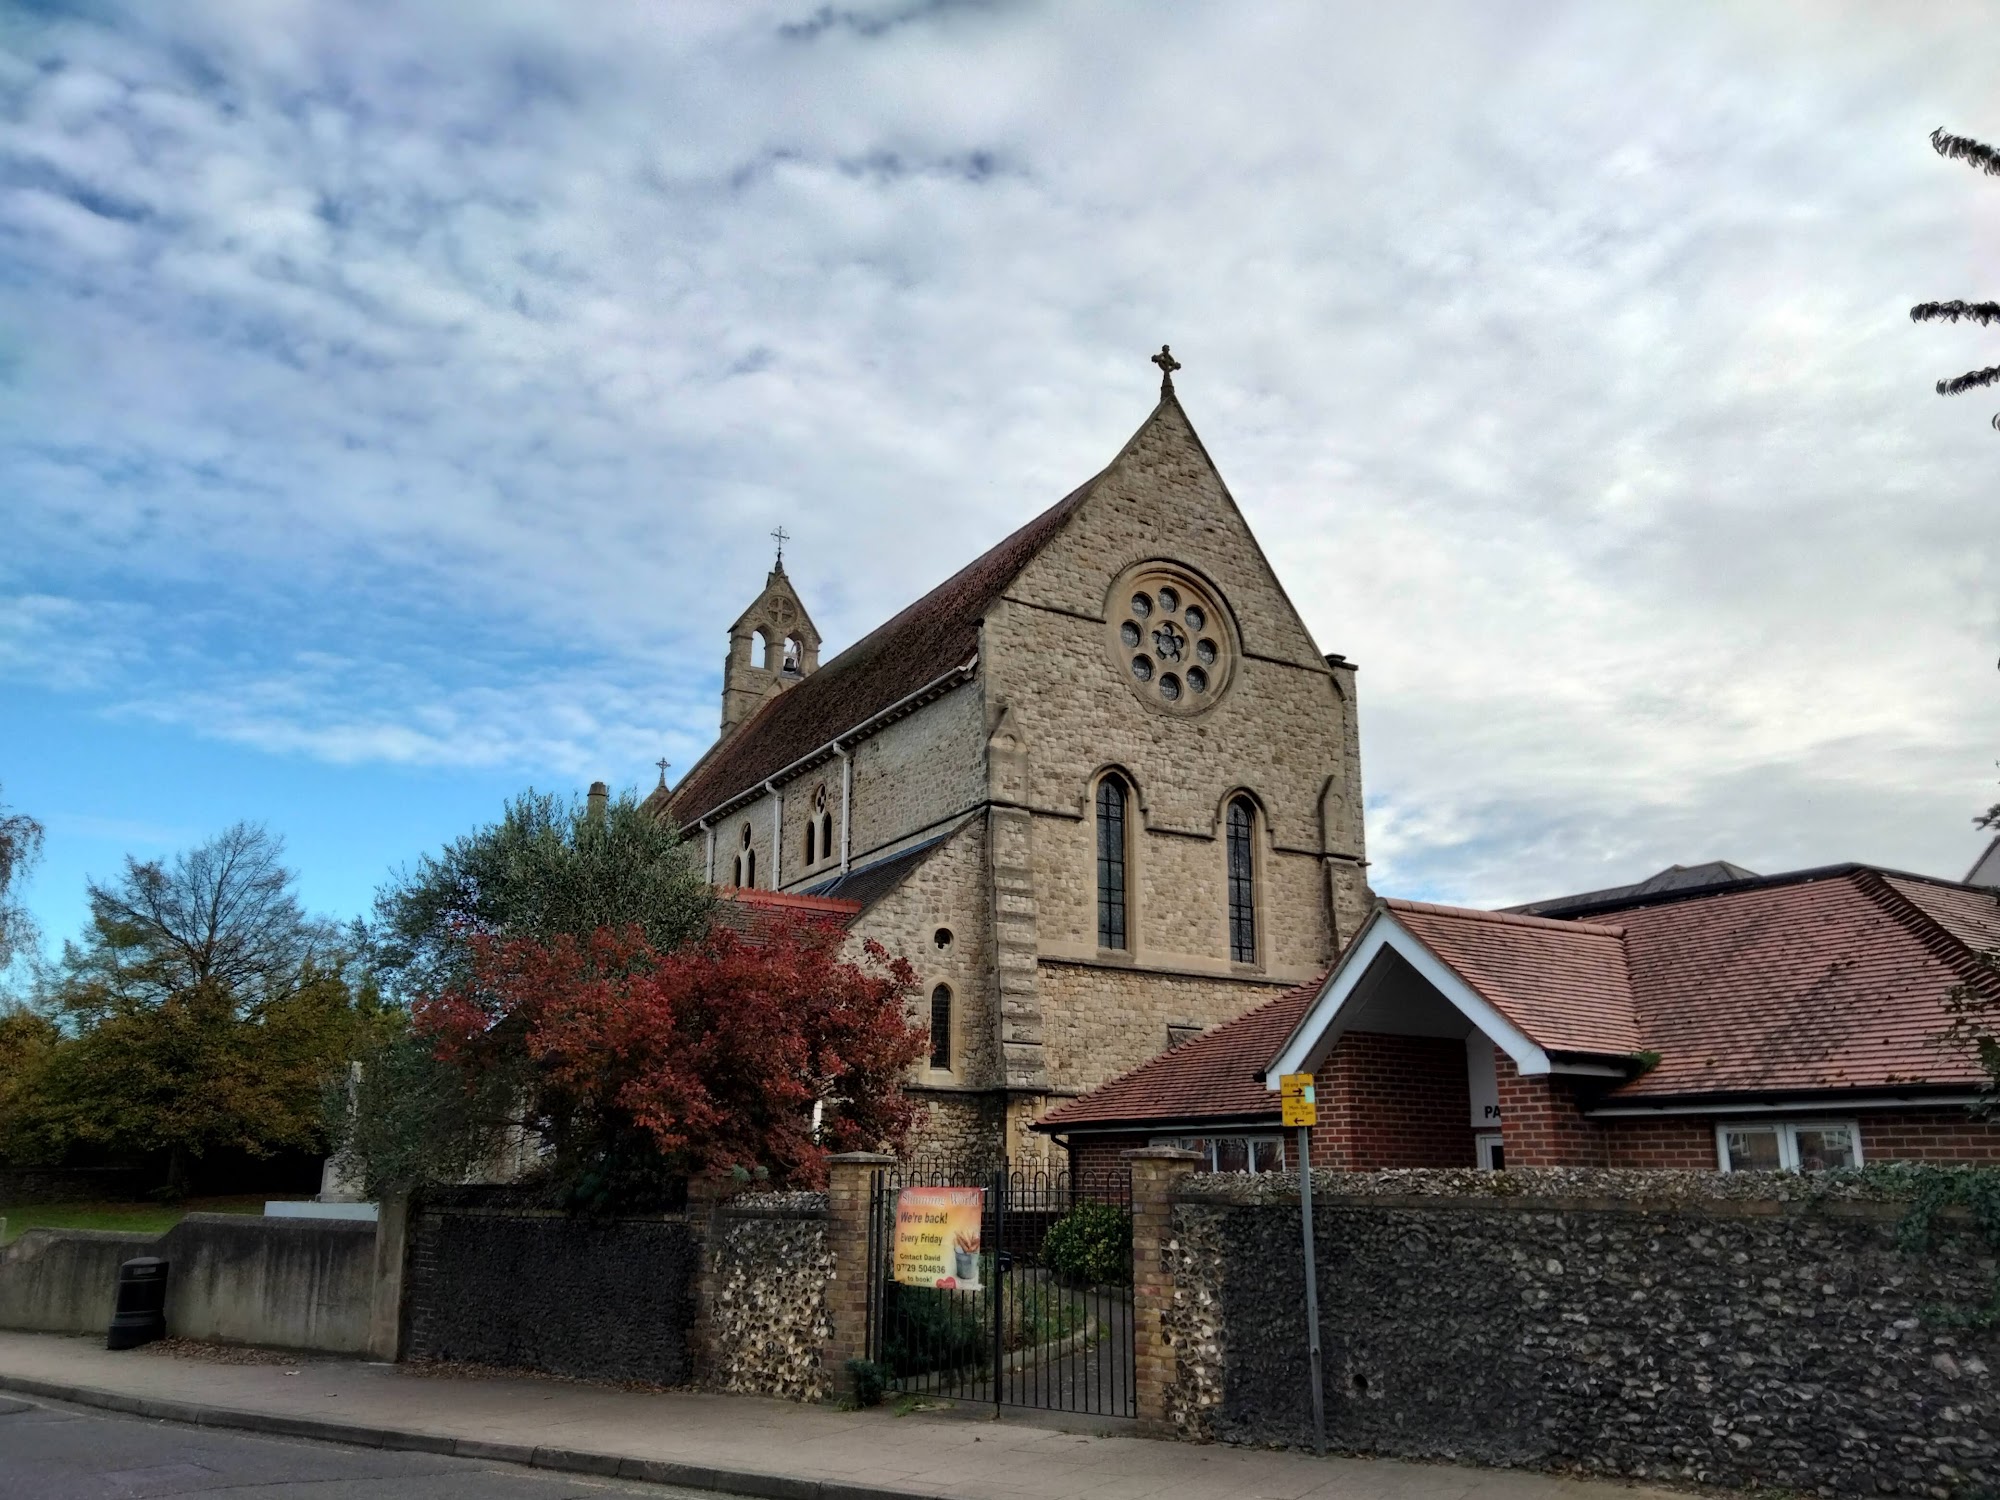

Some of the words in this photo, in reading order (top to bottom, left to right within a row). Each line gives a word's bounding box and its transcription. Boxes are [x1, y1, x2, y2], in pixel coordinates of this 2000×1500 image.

[950, 1191, 979, 1206] World
[900, 1211, 922, 1224] We're
[925, 1212, 948, 1224] back!
[900, 1232, 919, 1245] Every
[920, 1233, 943, 1246] Friday
[899, 1253, 922, 1261] Contact
[924, 1254, 941, 1262] David
[918, 1265, 946, 1274] 504636
